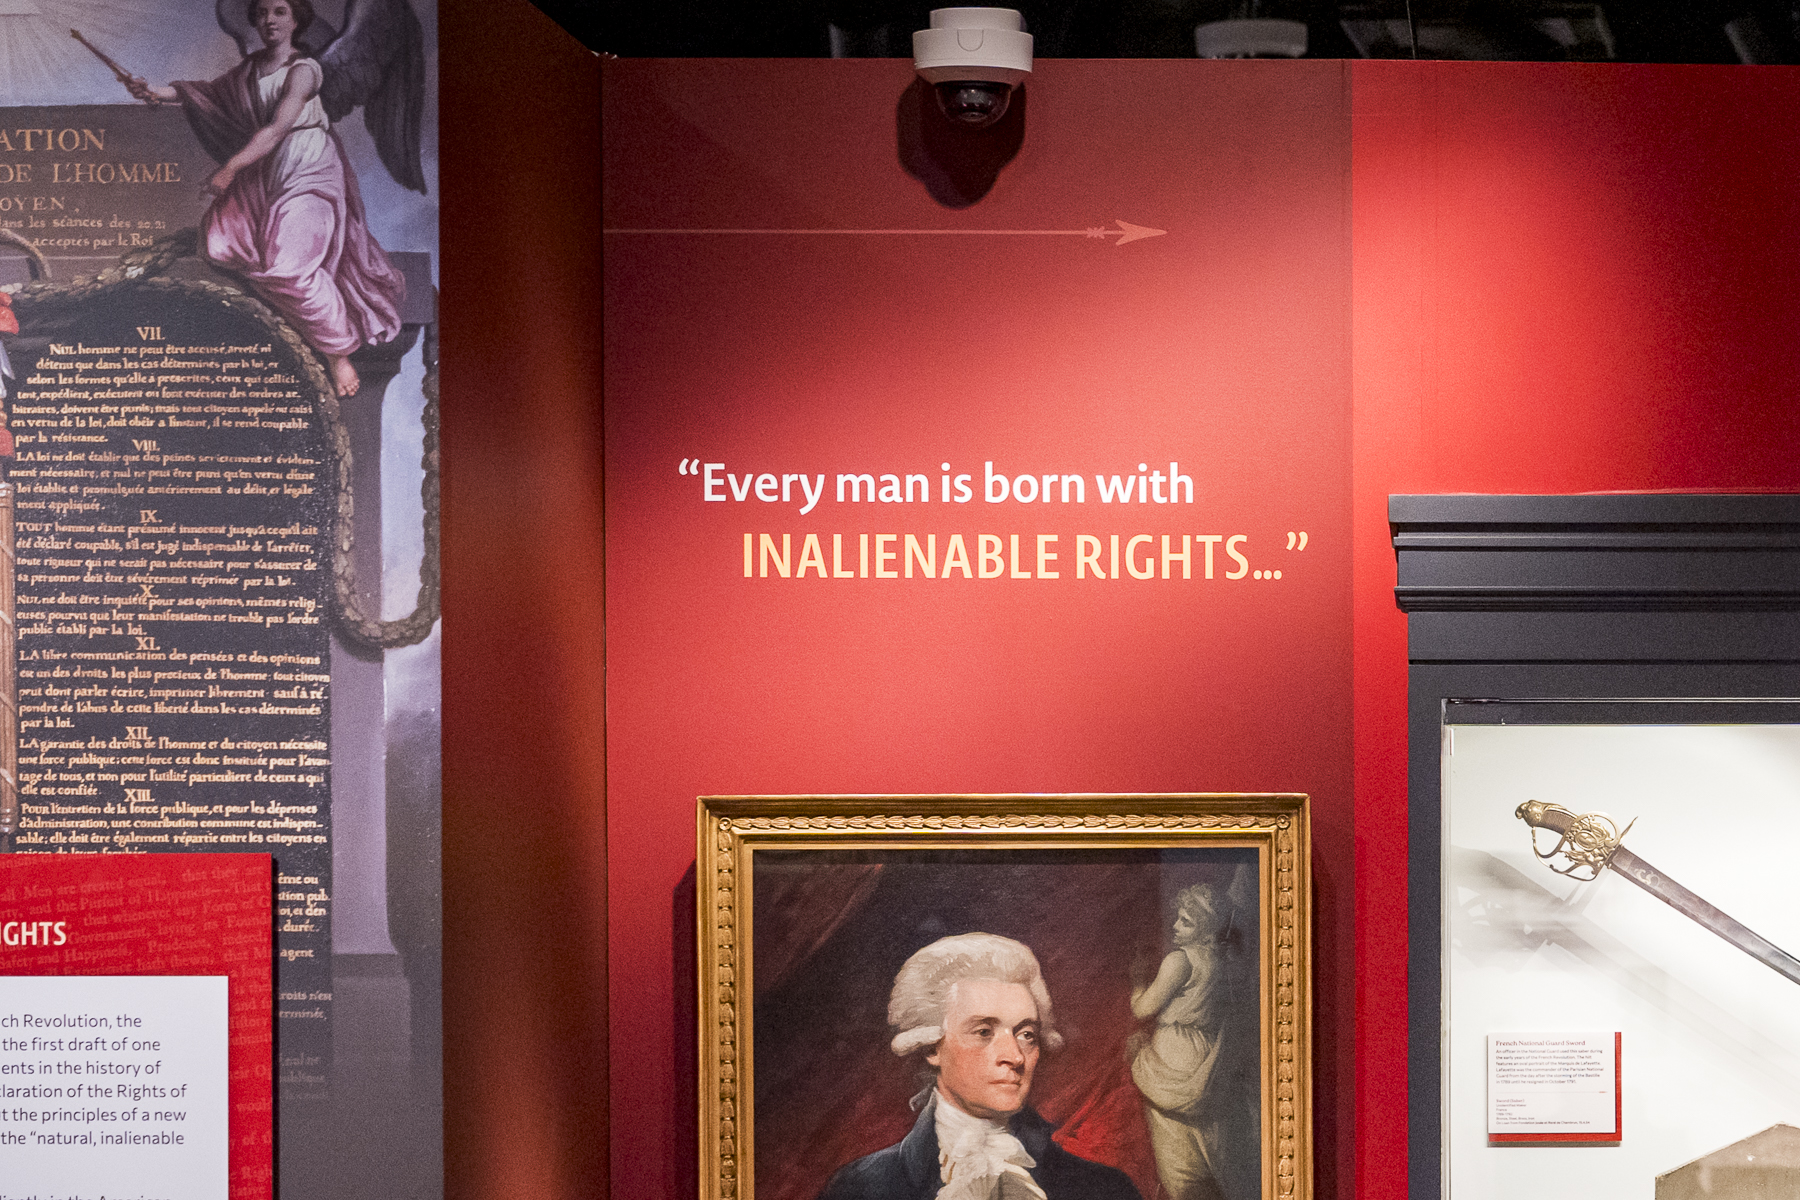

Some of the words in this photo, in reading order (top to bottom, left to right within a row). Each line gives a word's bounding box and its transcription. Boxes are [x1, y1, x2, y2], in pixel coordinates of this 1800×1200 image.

[78, 342, 121, 355] homme
[678, 458, 826, 516] “Every
[836, 473, 930, 503] man
[940, 461, 973, 504] is
[984, 460, 1086, 504] born
[1094, 461, 1194, 505] with
[743, 533, 1060, 580] INALIENABLE
[23, 1013, 113, 1030] Revolution,
[115, 1013, 142, 1028] the
[1, 1037, 28, 1052] the
[31, 1036, 64, 1052] first
[67, 1036, 107, 1052] draft
[111, 1036, 128, 1052] of
[131, 1040, 161, 1052] one
[38, 1060, 53, 1075] in
[56, 1060, 82, 1075] the
[86, 1060, 141, 1078] history
[144, 1059, 162, 1075] of
[66, 1083, 84, 1098] of
[87, 1084, 113, 1098] the
[117, 1083, 167, 1102] Rights
[170, 1083, 188, 1098] of
[11, 1107, 38, 1122] the
[41, 1107, 118, 1125] principles
[121, 1106, 138, 1122] of
[141, 1111, 150, 1122] a
[154, 1111, 187, 1122] new
[0, 1130, 27, 1145] the
[29, 1130, 97, 1147] “natural,
[100, 1130, 185, 1145] inalienable
